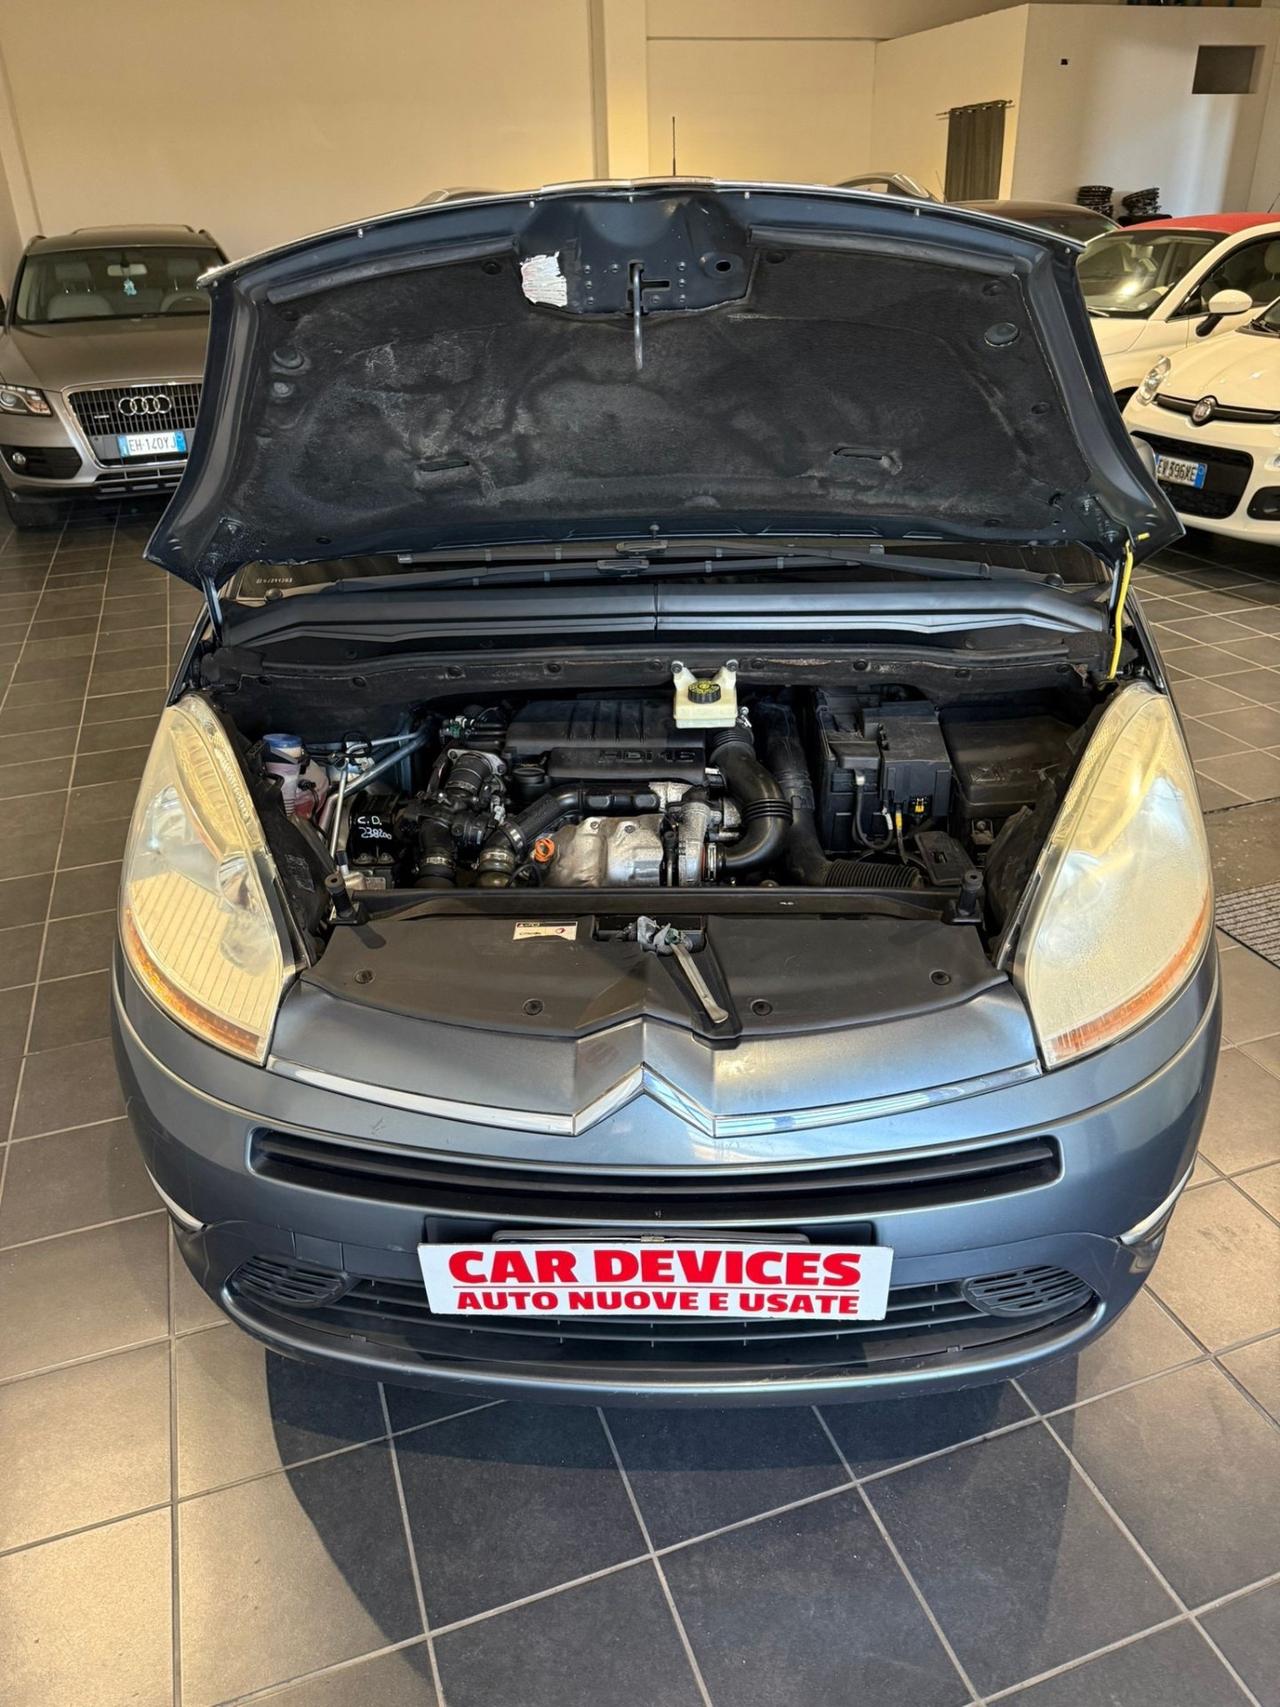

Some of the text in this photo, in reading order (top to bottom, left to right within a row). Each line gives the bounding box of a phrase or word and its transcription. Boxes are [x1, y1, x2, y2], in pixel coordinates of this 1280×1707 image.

[447, 1249, 861, 1287] CAR DEVICES
[457, 1291, 858, 1314] AUTO NUOVE E USATE
